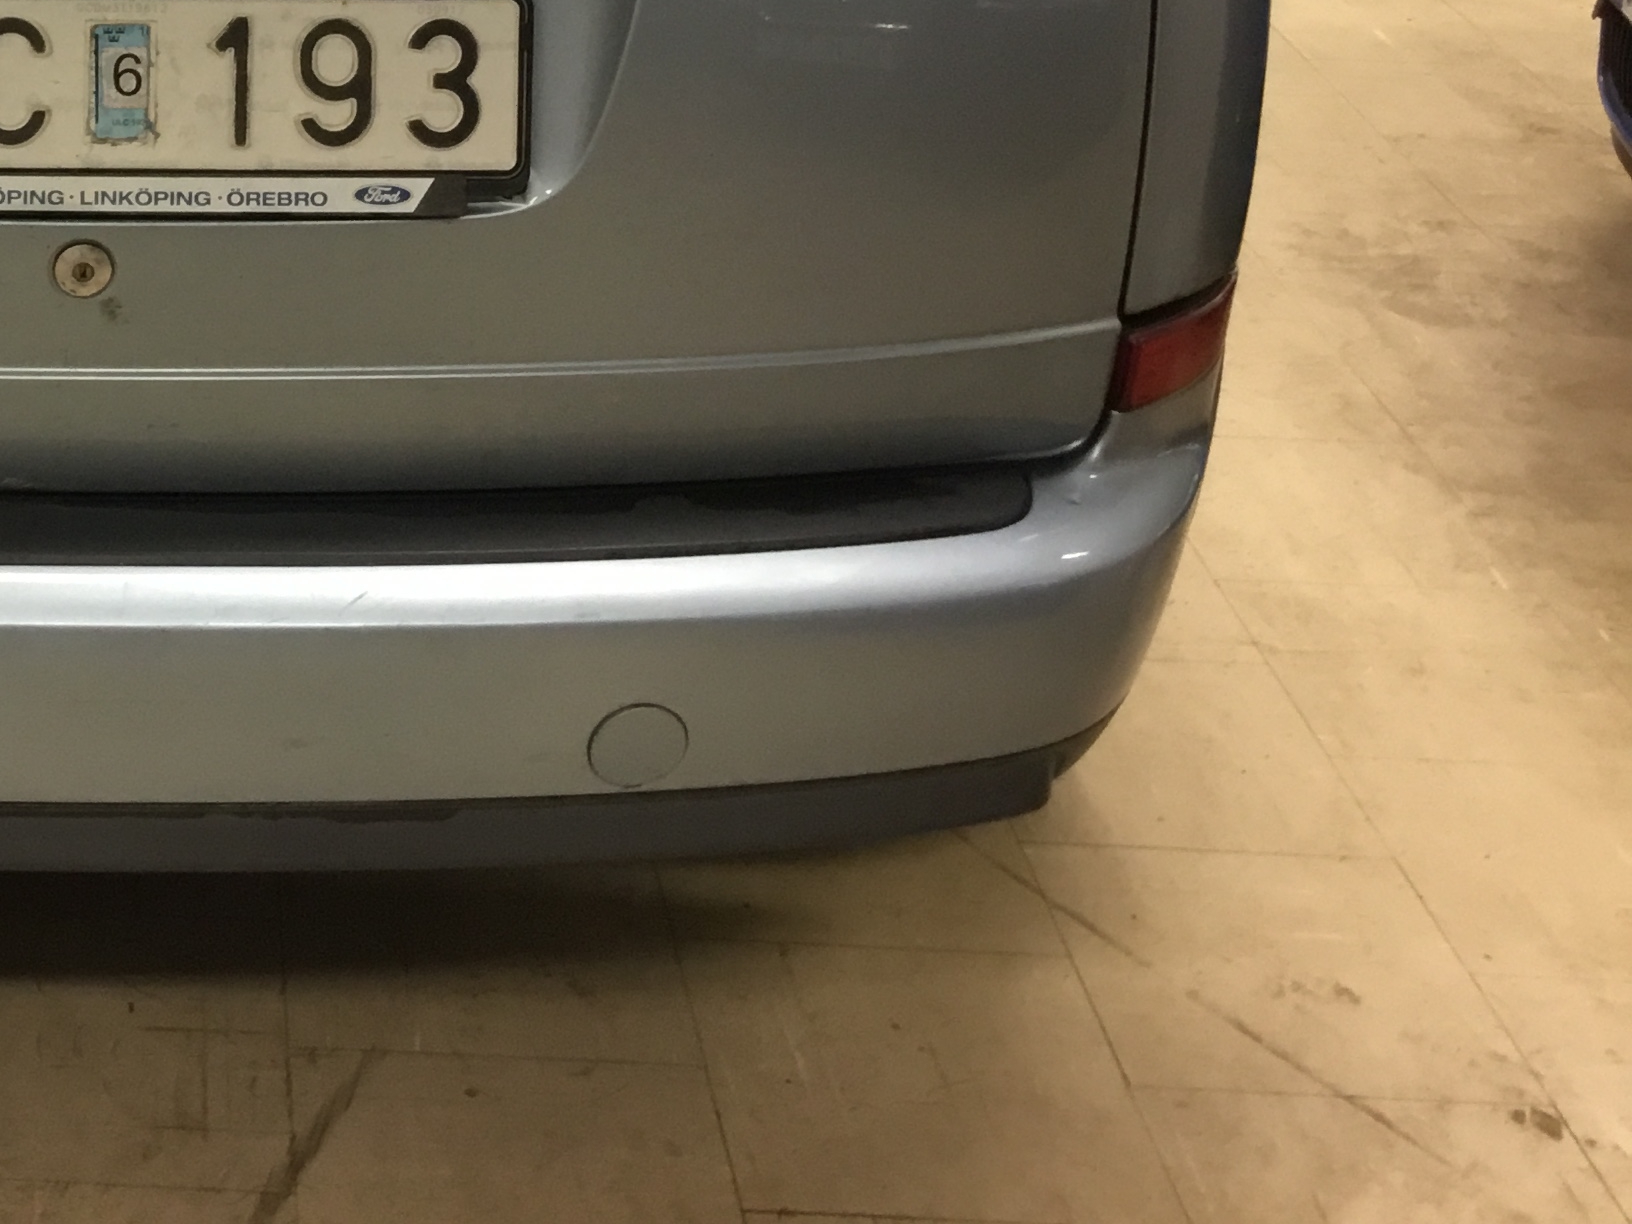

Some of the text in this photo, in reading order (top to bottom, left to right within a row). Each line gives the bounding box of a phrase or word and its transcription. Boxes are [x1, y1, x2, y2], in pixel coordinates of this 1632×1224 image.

[112, 52, 143, 97] 6
[214, 16, 482, 149] 193
[79, 187, 212, 207] LINKÖPING
[226, 188, 329, 208] ÖREBRO
[363, 185, 401, 203] Ford
